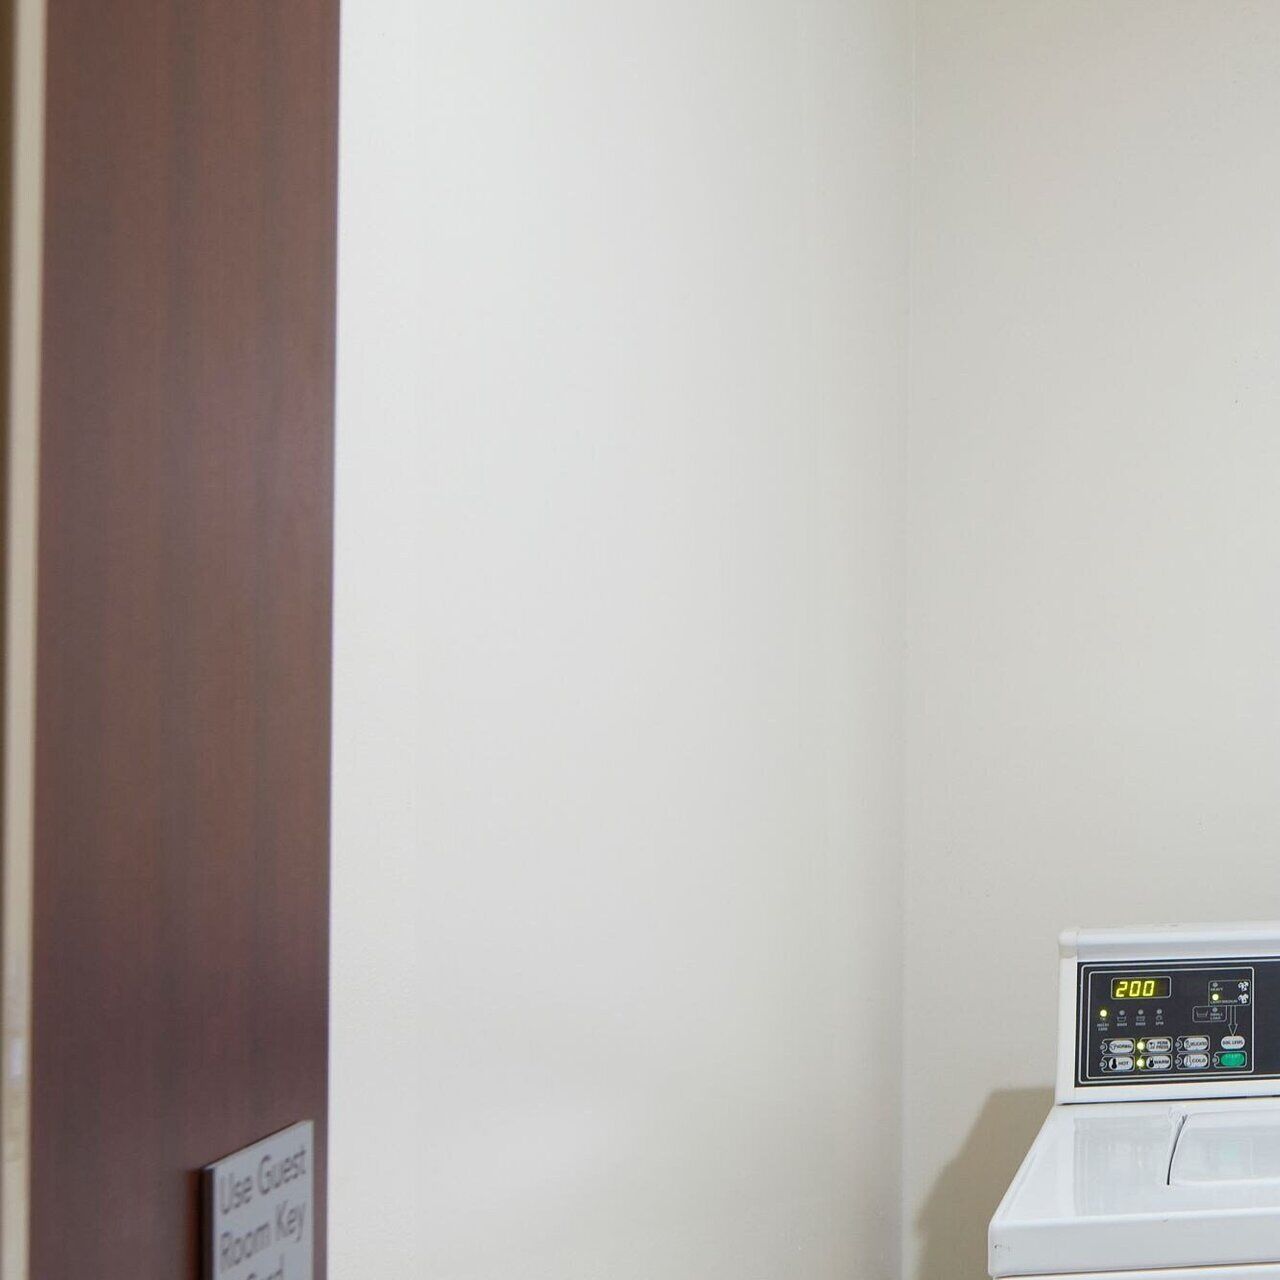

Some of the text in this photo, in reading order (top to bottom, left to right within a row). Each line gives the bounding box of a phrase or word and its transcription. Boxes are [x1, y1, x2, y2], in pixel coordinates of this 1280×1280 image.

[1115, 980, 1155, 998] 200
[220, 1145, 306, 1215] Use Guest
[220, 1200, 306, 1274] Room Key
